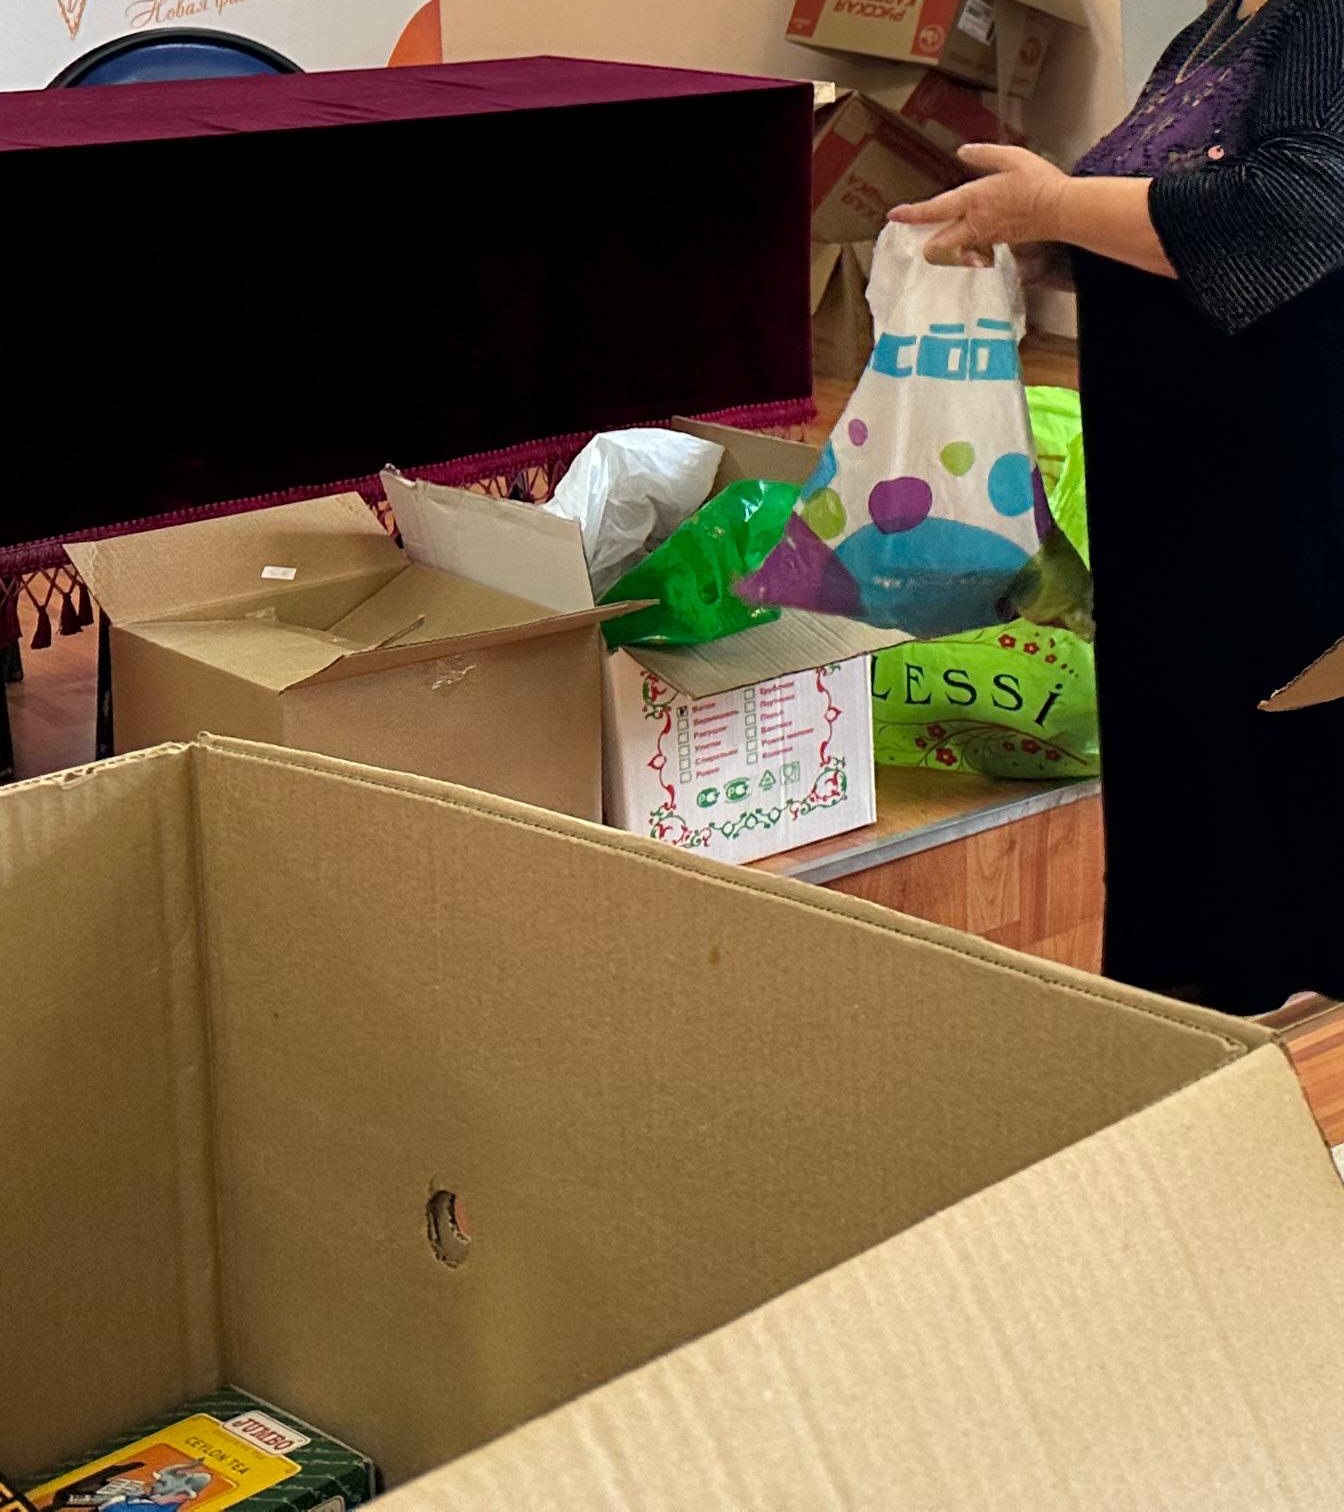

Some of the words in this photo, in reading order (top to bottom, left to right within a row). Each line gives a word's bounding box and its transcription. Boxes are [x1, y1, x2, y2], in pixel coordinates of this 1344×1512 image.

[232, 1417, 294, 1451] JUMBO
[185, 1436, 228, 1462] CEYLON
[229, 1458, 250, 1475] TEA
